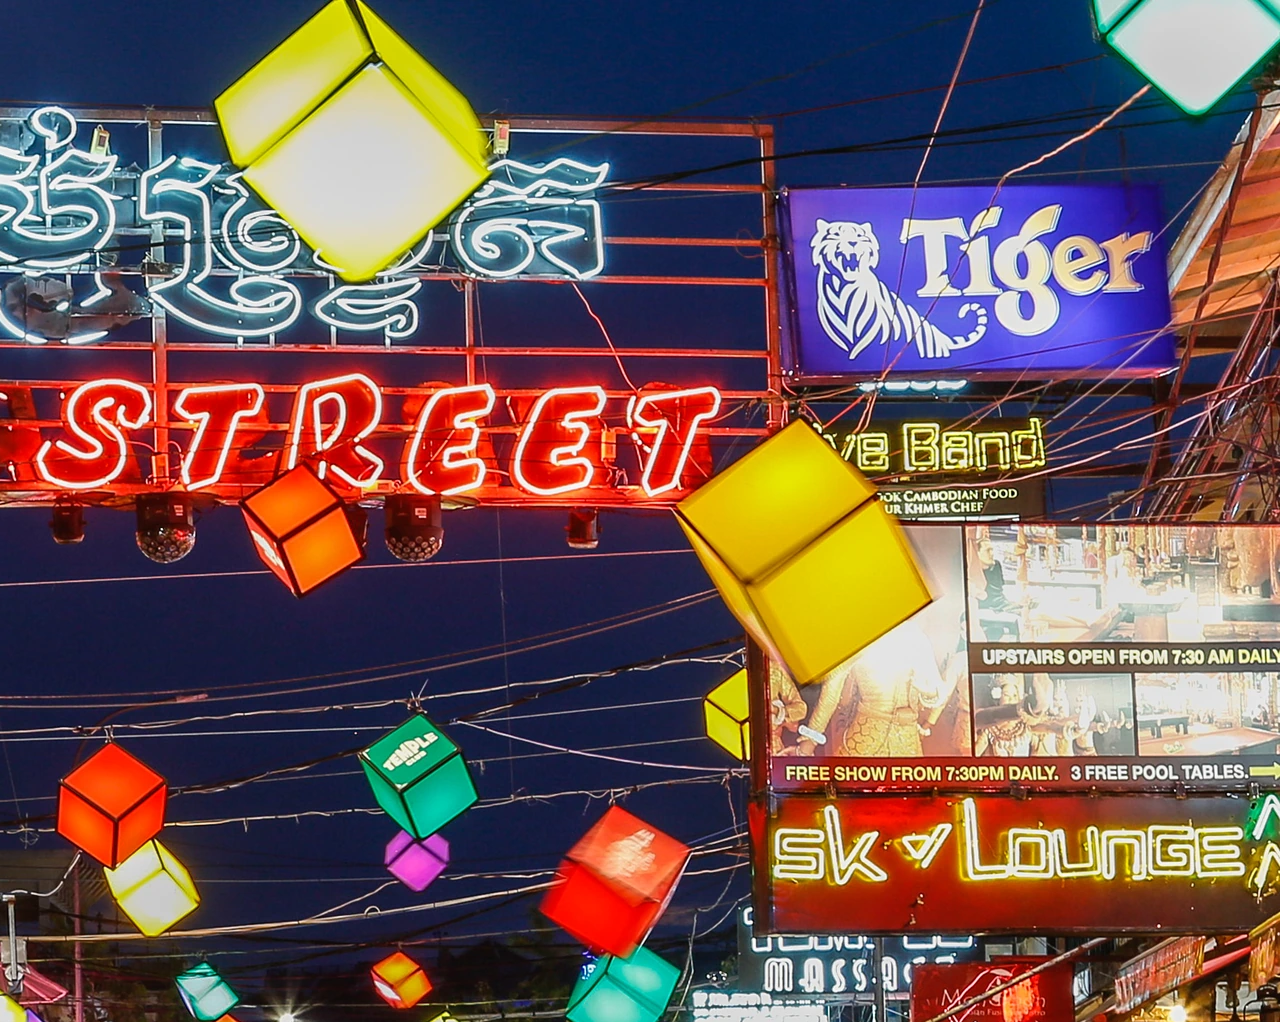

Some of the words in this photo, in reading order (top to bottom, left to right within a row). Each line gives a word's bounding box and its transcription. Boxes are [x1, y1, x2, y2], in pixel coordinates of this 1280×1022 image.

[901, 204, 1153, 337] Tiger
[37, 372, 722, 498] STREET
[903, 417, 1046, 471] Band
[884, 503, 902, 514] UR
[904, 502, 949, 515] KHMER
[951, 501, 984, 513] CHEF
[903, 490, 979, 502] CAMBODIAN
[982, 487, 1018, 500] FOOD
[982, 648, 1066, 666] UPSTAIRS
[1069, 648, 1117, 665] OPEN
[1120, 648, 1169, 665] FROM
[1173, 648, 1204, 665] 7:30
[1208, 648, 1235, 665] AM
[382, 732, 439, 771] TEMPLE
[785, 765, 831, 782] FREE
[834, 765, 888, 782] SHOW
[891, 765, 943, 782] FROM
[945, 764, 1005, 782] 7:30PM
[1008, 764, 1060, 782] DAILY.
[1071, 764, 1082, 781] 3
[1085, 764, 1129, 781] FREE
[1132, 763, 1178, 781] POOL
[1181, 762, 1250, 780] TABLES.
[763, 955, 957, 993] MASSA
